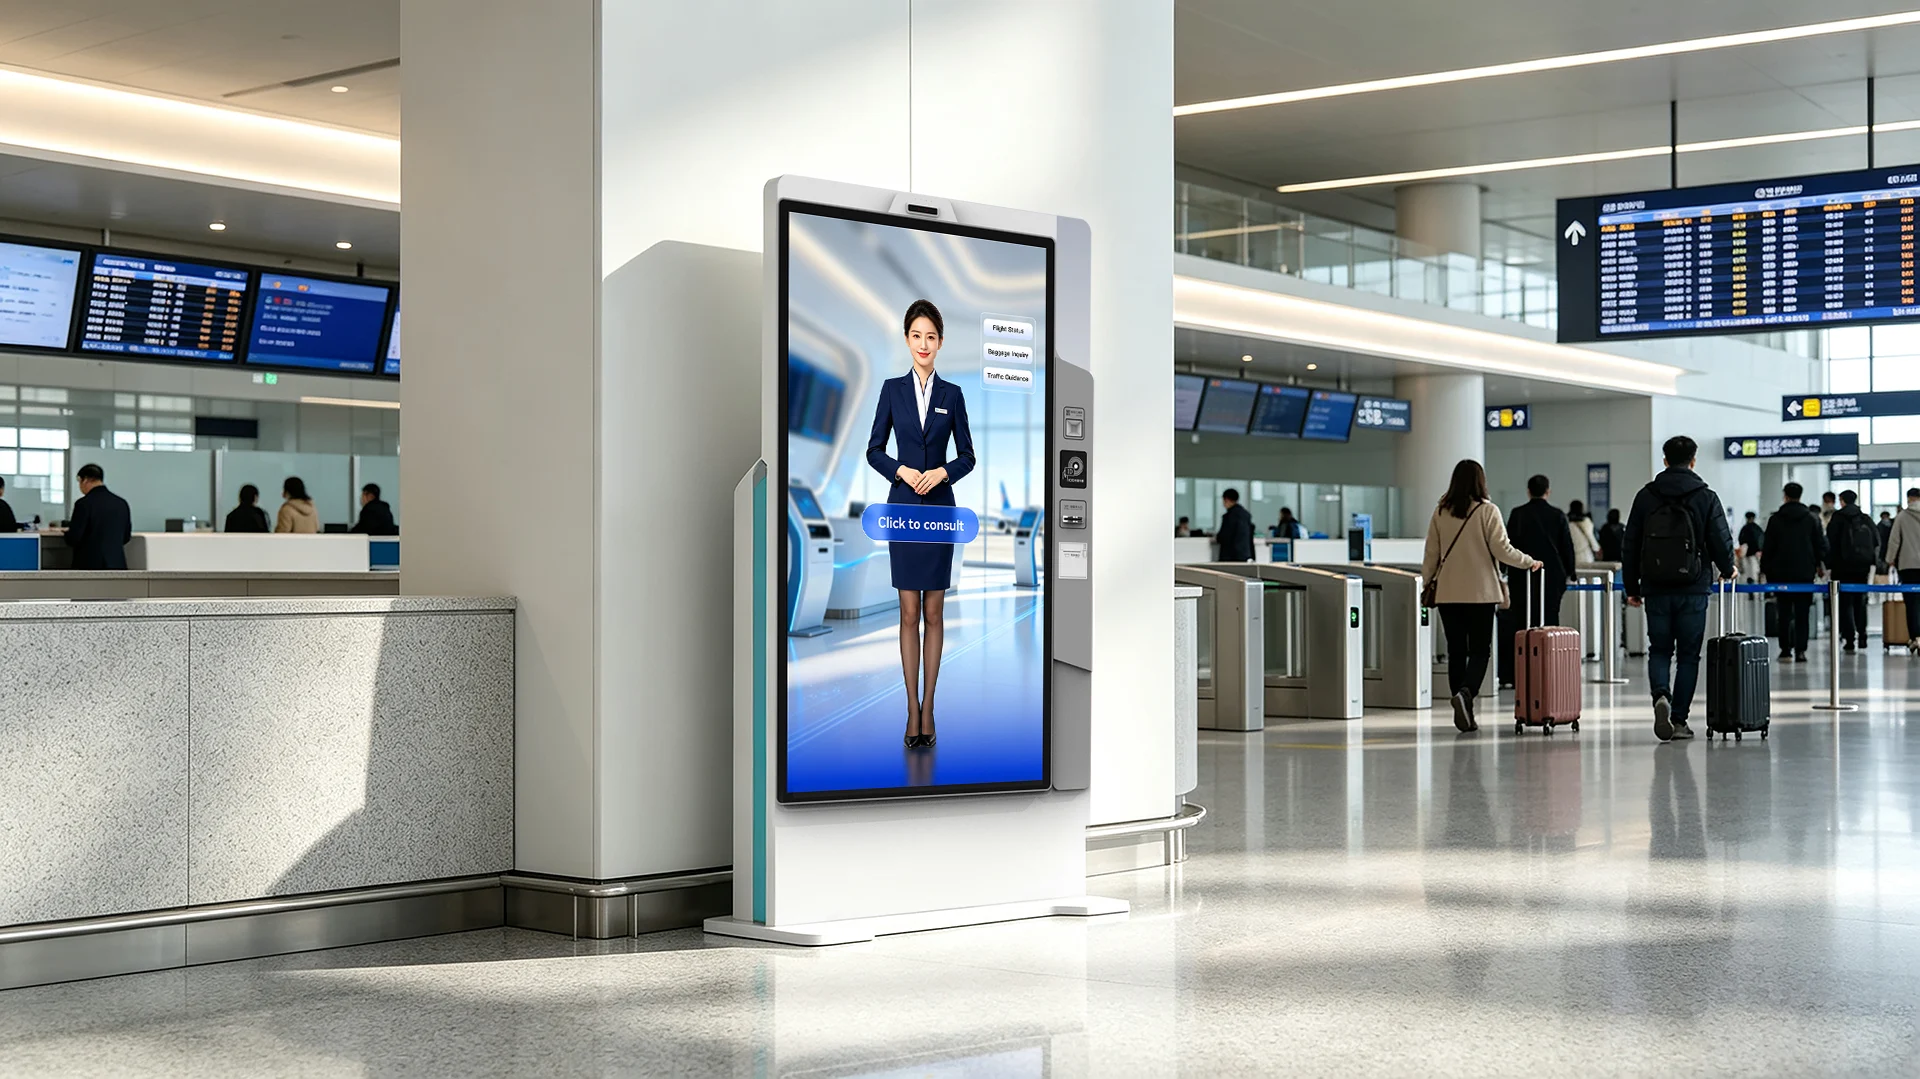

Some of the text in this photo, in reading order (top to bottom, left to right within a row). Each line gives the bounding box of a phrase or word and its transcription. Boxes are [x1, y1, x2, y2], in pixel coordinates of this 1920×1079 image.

[878, 516, 965, 532] Click to consult
